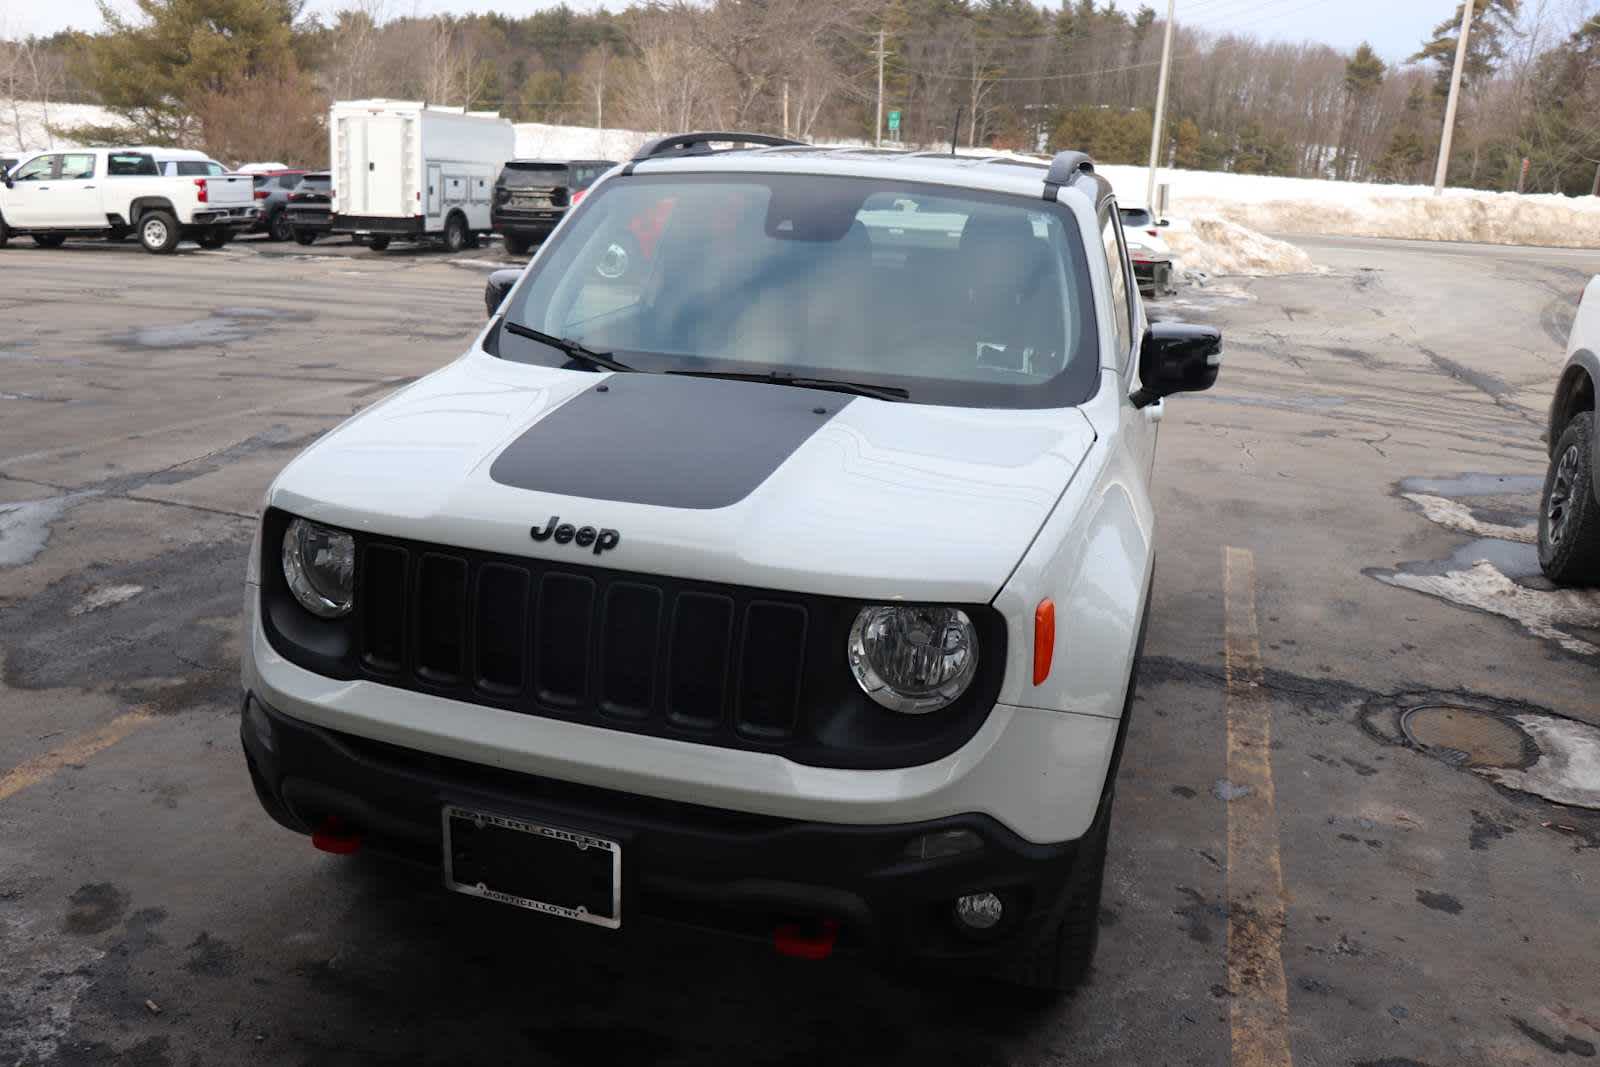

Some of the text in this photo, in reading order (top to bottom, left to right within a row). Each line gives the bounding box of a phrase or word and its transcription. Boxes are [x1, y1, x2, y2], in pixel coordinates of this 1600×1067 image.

[530, 515, 620, 555] Jeep
[541, 827, 611, 850] GREEN
[564, 909, 581, 918] NY
